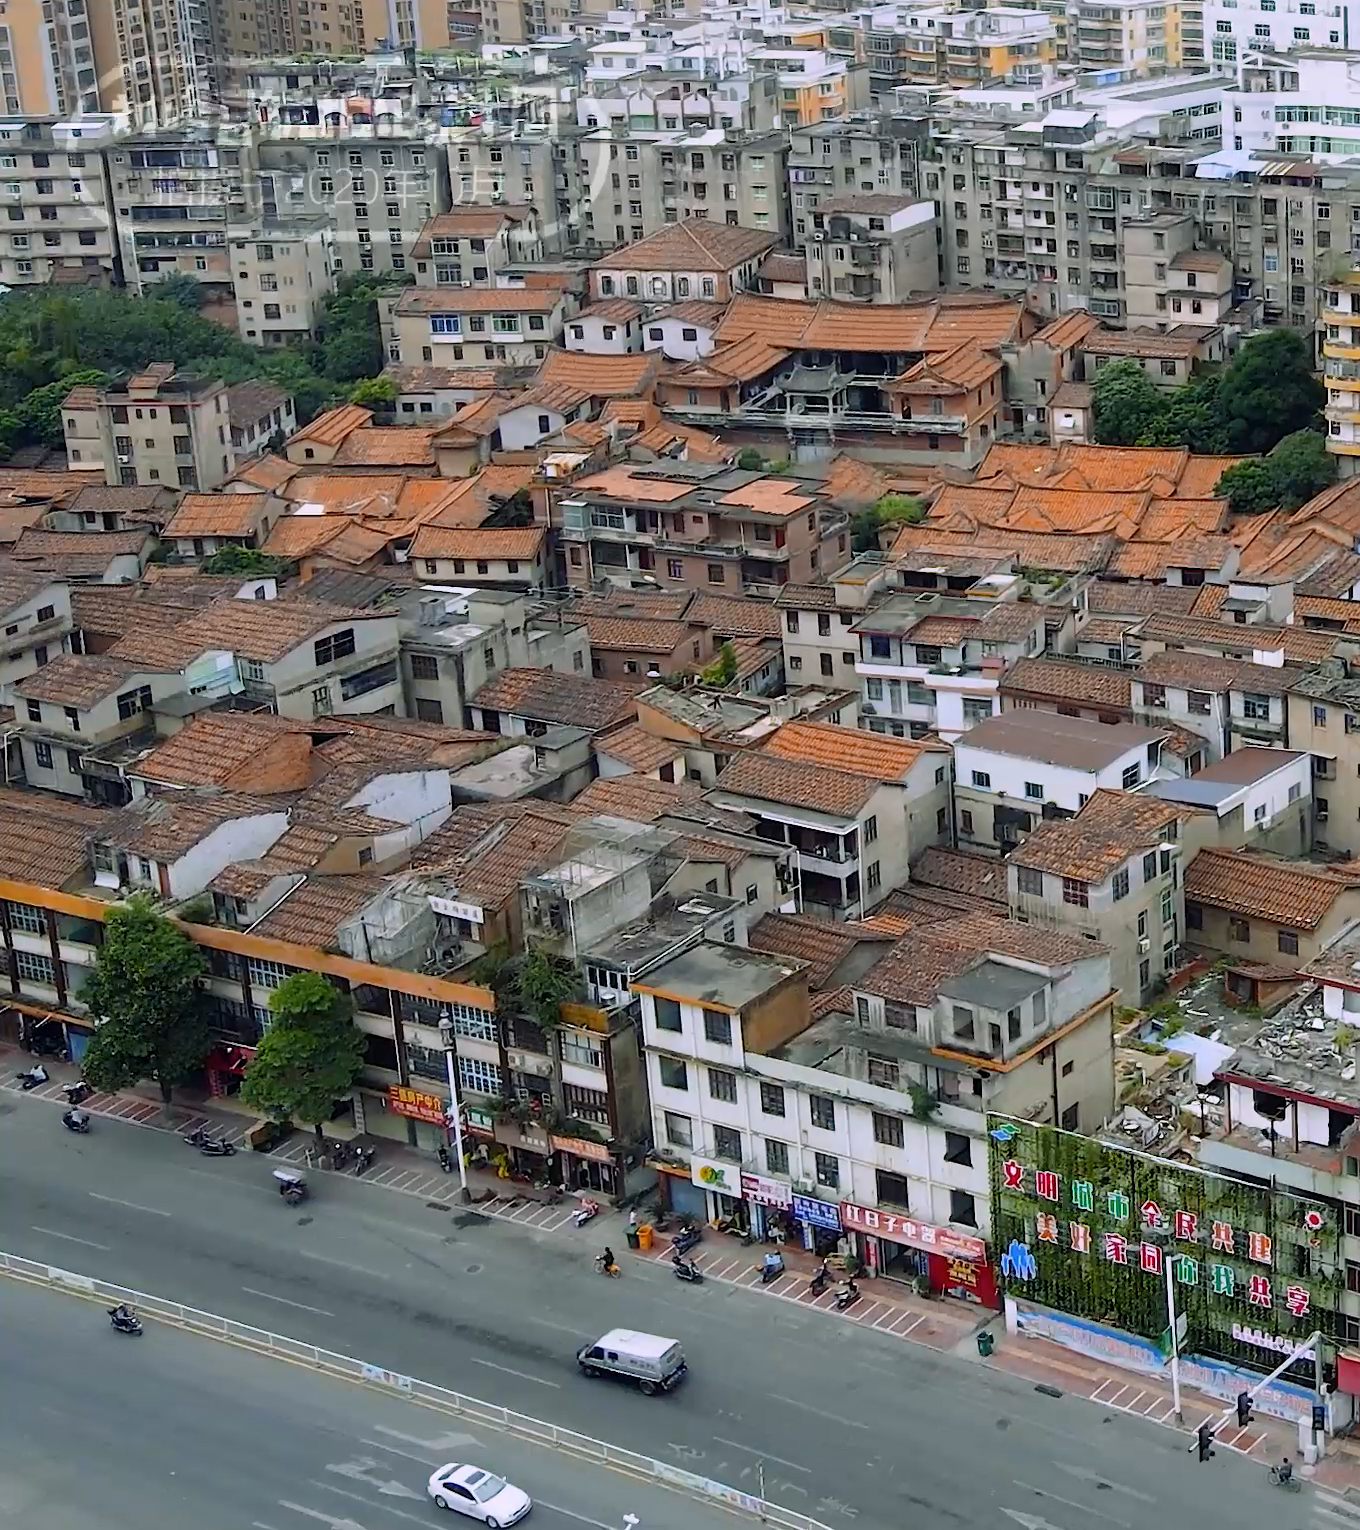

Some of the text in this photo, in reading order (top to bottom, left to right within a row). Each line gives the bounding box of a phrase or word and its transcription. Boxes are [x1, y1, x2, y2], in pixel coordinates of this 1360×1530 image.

[845, 1204, 937, 1245] 红日子电器
[1002, 1159, 1272, 1266] 文明城市全民共建
[1036, 1211, 1311, 1318] 美好家园你我共享
